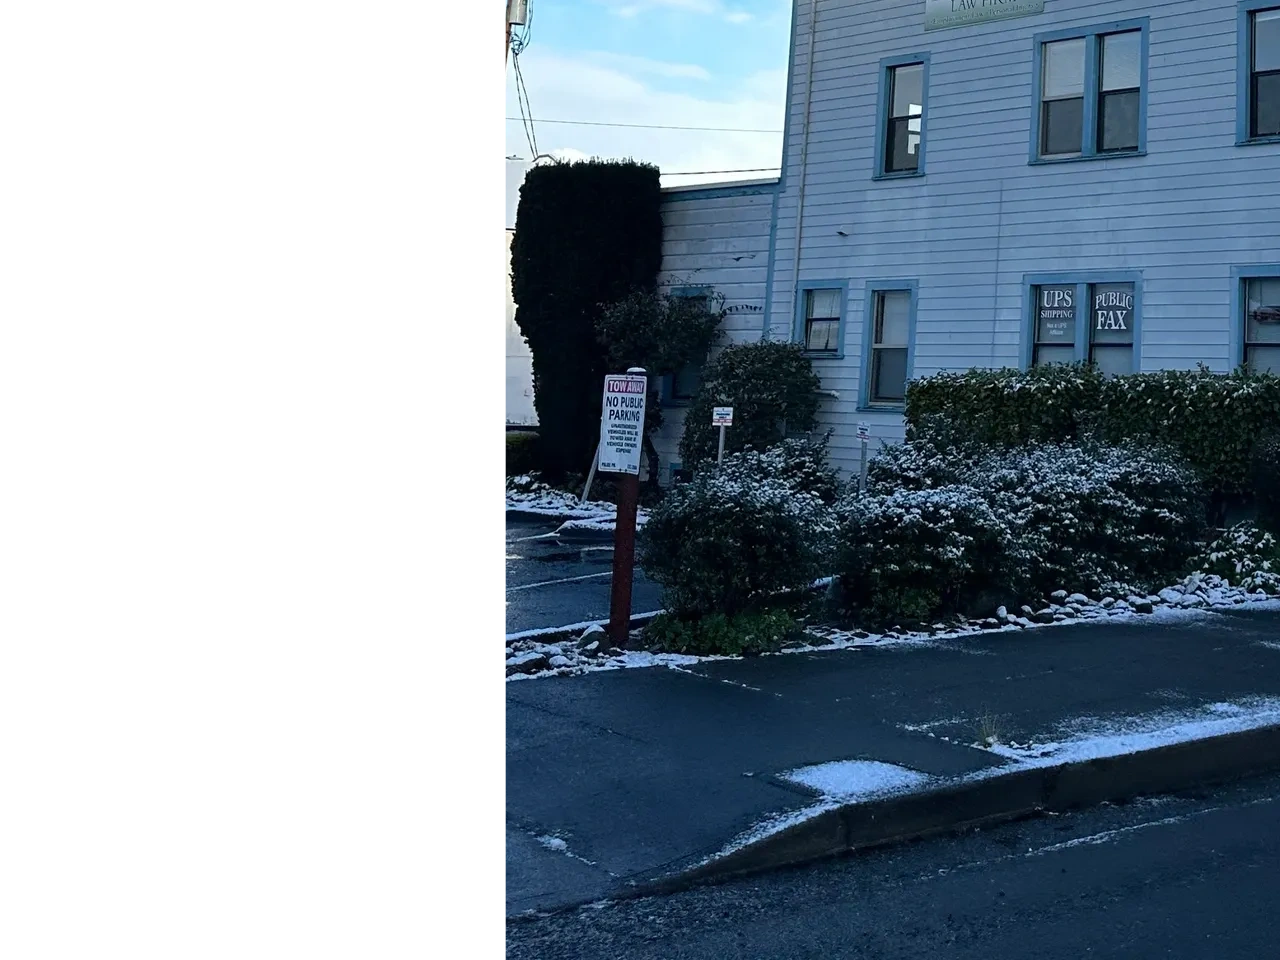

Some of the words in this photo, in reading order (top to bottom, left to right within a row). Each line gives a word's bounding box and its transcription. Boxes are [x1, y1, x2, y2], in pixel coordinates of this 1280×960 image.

[1043, 290, 1073, 308] UPS
[1095, 291, 1133, 310] PUBLIC
[1040, 310, 1073, 319] SHIPPING
[1096, 310, 1128, 330] FAX
[609, 380, 627, 392] TOW
[627, 381, 644, 393] AWAY
[605, 396, 619, 408] NO
[620, 396, 644, 409] PUBLIC
[608, 409, 641, 422] PARKING
